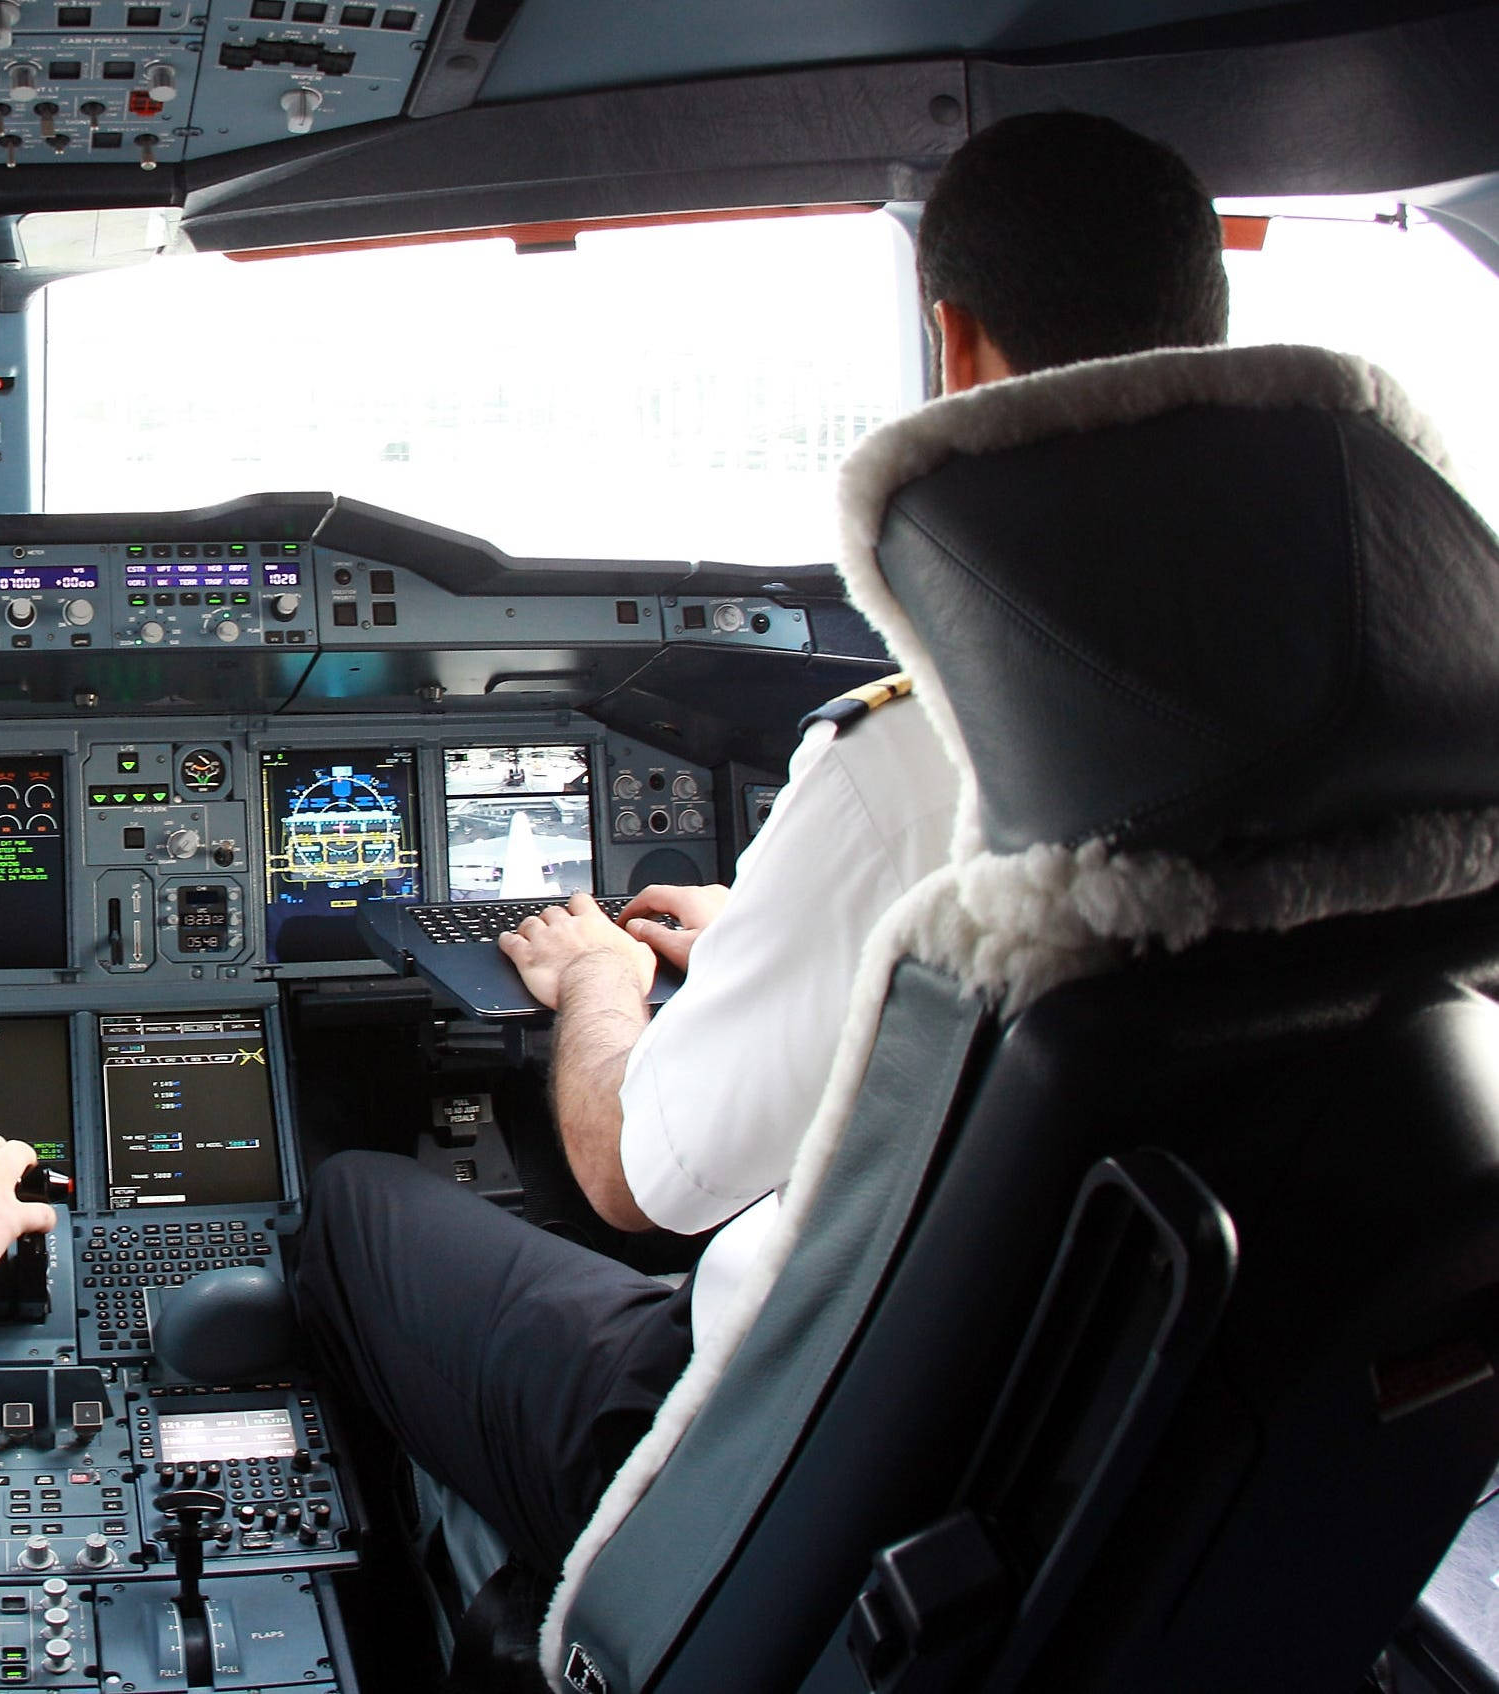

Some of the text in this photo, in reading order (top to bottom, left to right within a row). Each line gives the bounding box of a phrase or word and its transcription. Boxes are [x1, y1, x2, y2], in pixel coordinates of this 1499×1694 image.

[269, 573, 298, 585] 1028
[0, 577, 41, 590] 07000
[120, 1251, 127, 1259] E
[103, 1277, 111, 1285] Z
[121, 1277, 129, 1285] X
[252, 1630, 285, 1639] FLAPS
[222, 1665, 240, 1673] FULL
